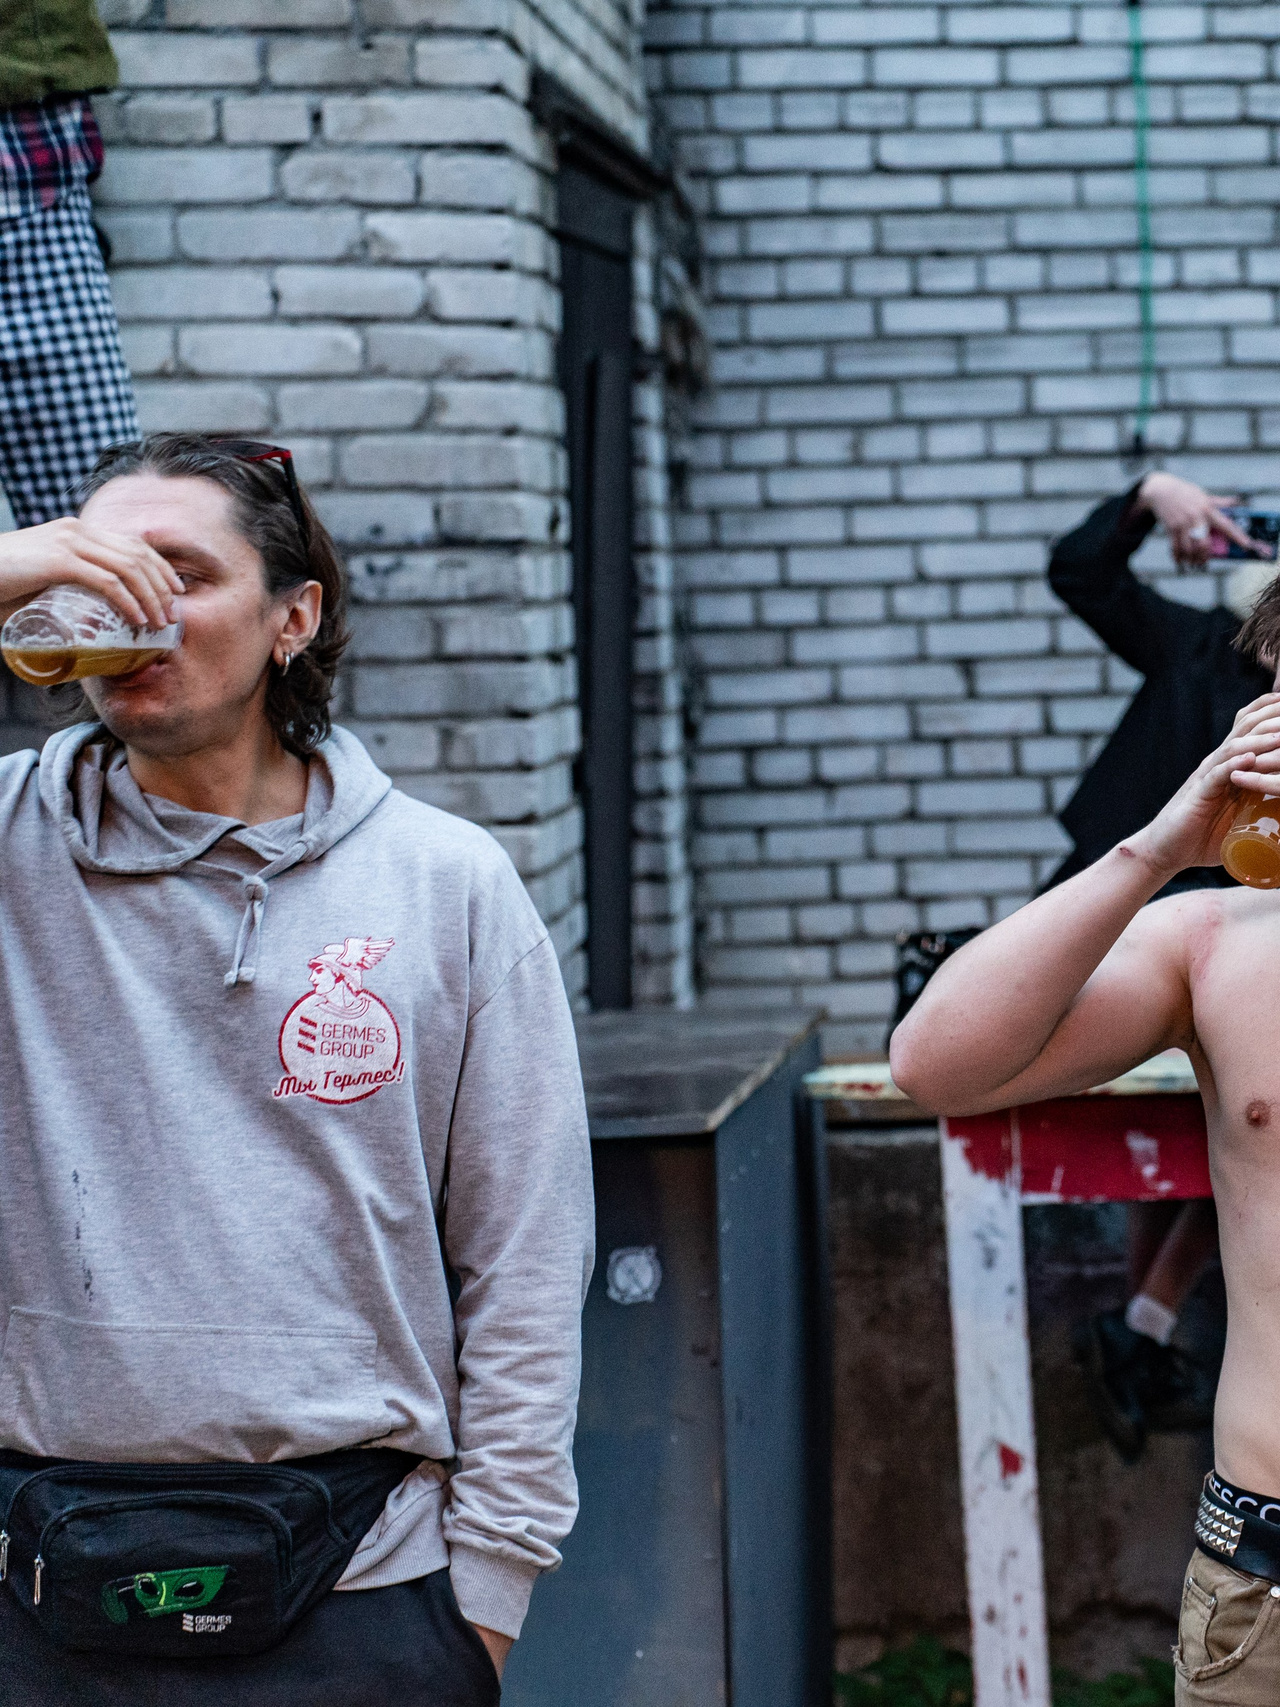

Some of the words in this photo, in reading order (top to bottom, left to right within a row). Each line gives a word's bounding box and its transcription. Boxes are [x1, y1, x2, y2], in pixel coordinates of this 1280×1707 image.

[321, 1023, 387, 1044] GERMES
[320, 1041, 375, 1059] GROUP
[274, 1076, 317, 1097] Мы
[195, 1615, 232, 1625] GERMES
[195, 1624, 226, 1633] GROUP
